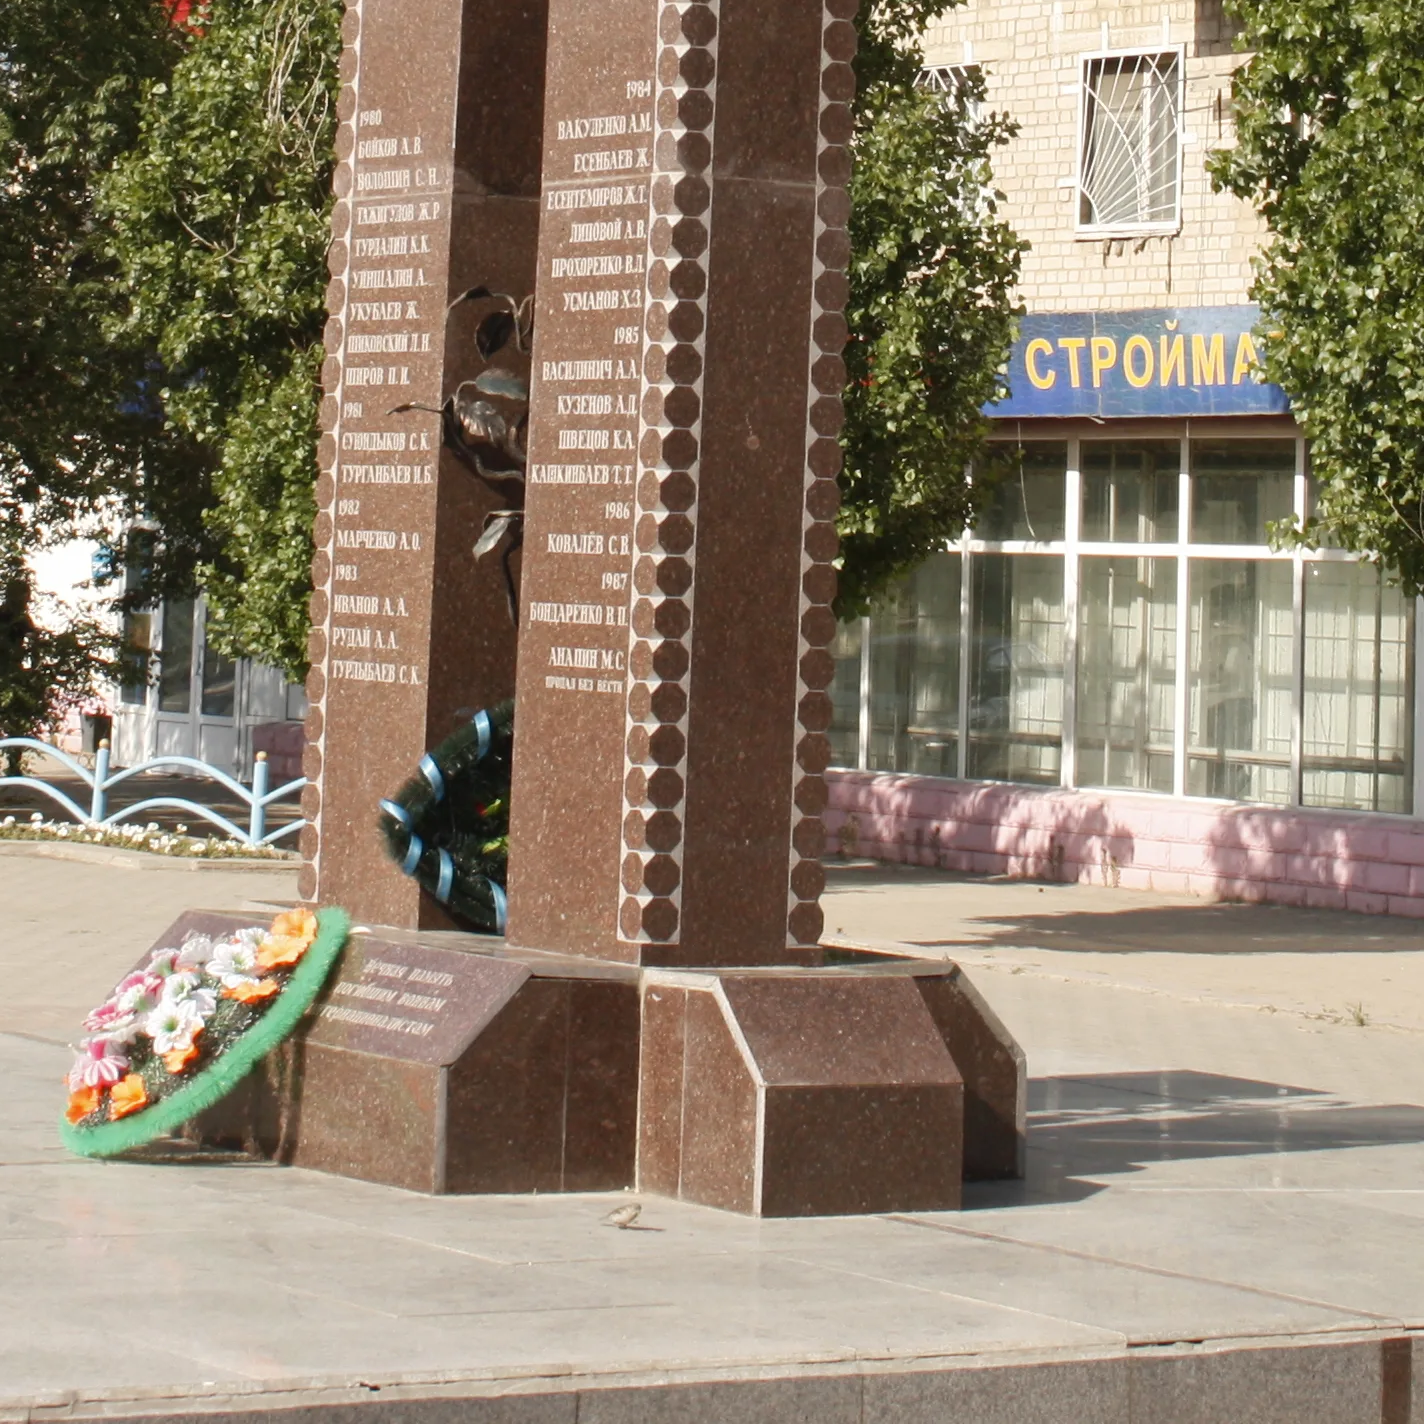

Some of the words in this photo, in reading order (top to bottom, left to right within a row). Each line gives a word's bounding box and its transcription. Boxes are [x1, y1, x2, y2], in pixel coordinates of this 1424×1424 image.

[359, 109, 382, 127] 1980
[557, 116, 626, 140] ВАКУЛЕНКО
[573, 150, 633, 173] ЕСЕНБАЕВ
[551, 255, 622, 278] ПРОХОРЕНКО
[562, 290, 619, 312] УСМАНОВ
[614, 326, 639, 345] 1985
[1025, 319, 1284, 390] СТРОЙМА
[557, 395, 612, 415] КУЗЕНОВ
[558, 429, 610, 452] ШВЕЦОВ
[338, 500, 360, 516] 1982
[605, 502, 630, 519] 1986
[336, 530, 396, 549] МАРЧЕНКО
[335, 565, 358, 582] 1983
[601, 572, 628, 590] 1987
[333, 595, 379, 614] ИВАНОВ
[529, 602, 603, 625] БОНДАРЕНКО
[332, 626, 371, 648] РУДАЙ
